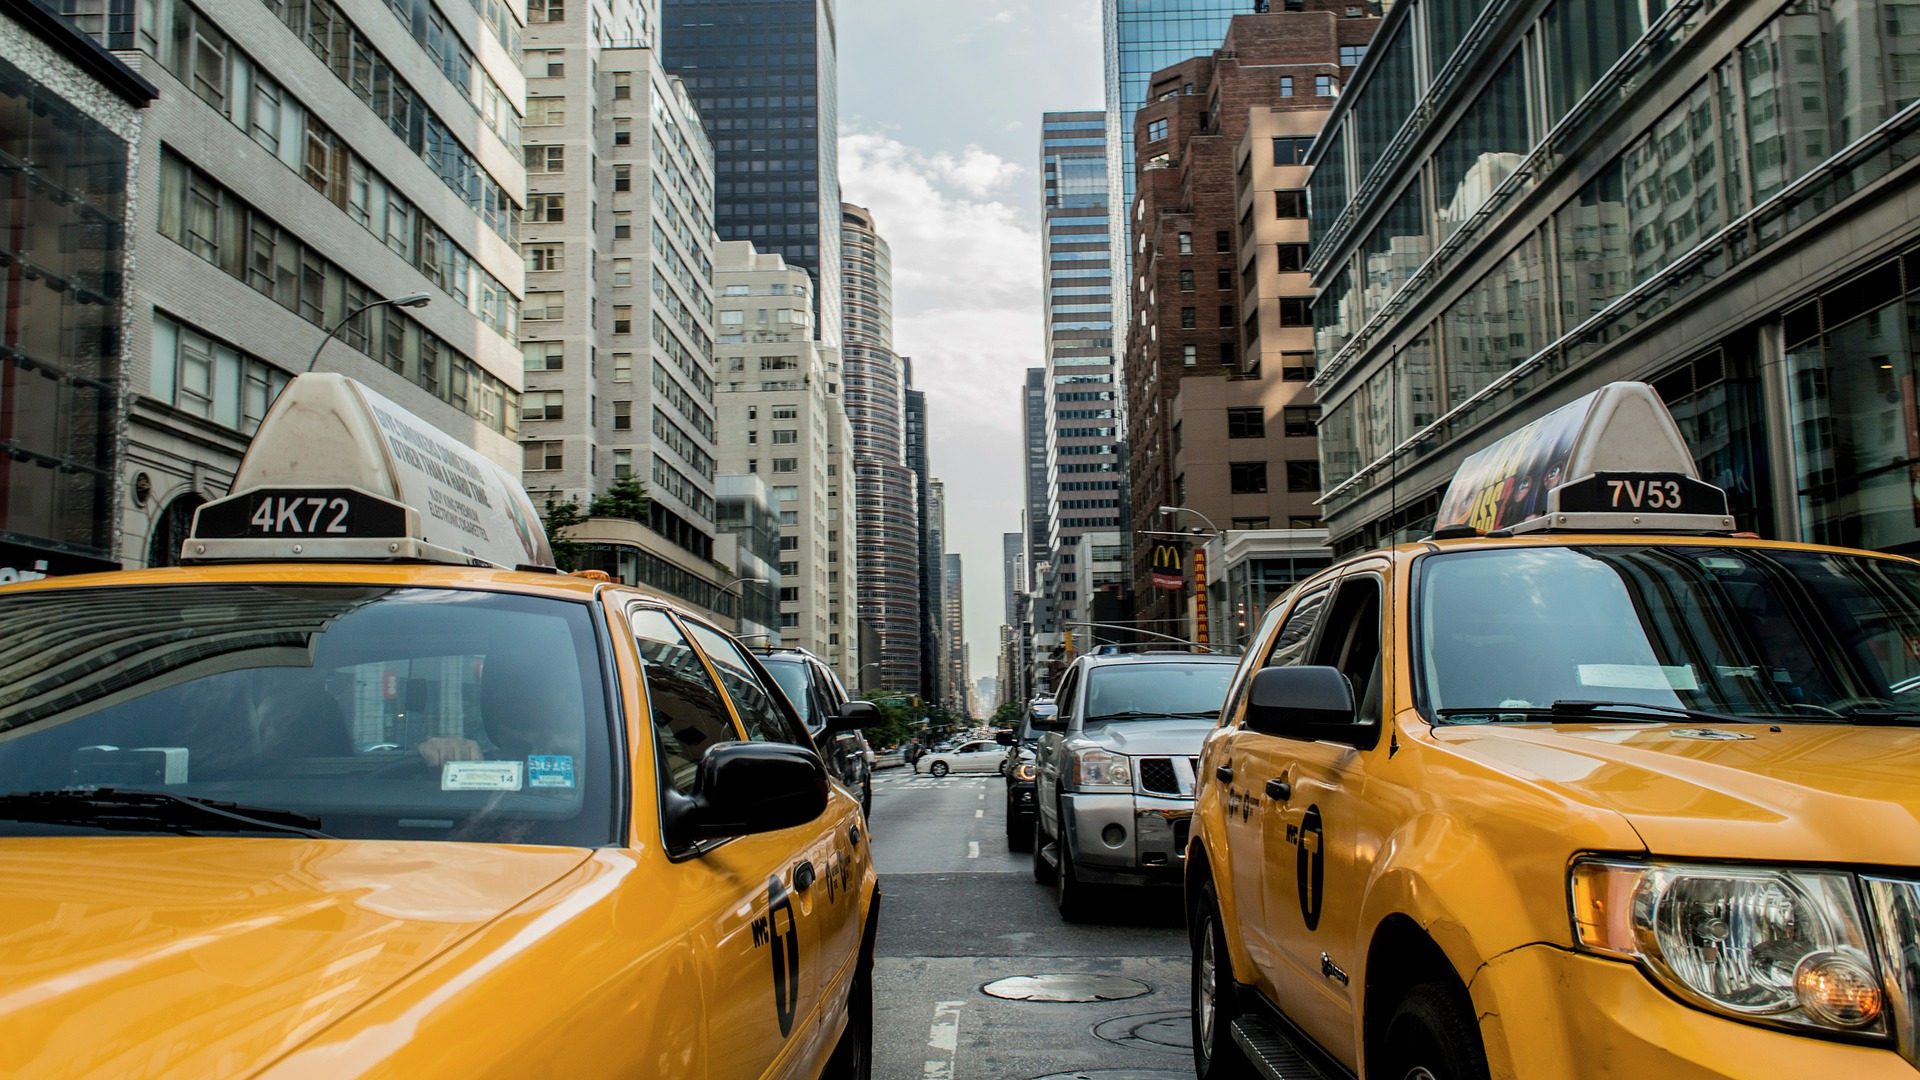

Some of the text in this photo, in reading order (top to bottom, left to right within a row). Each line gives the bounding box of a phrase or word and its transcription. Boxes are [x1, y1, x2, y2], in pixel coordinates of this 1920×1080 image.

[388, 435, 425, 473] OTHER
[418, 453, 446, 485] THAN
[441, 465, 454, 488] A
[445, 468, 473, 499] HARD
[1607, 480, 1682, 508] 7V53
[251, 497, 350, 533] 4K72
[450, 774, 514, 783] 2 14
[1286, 823, 1299, 846] NYC
[751, 916, 769, 949] NYC
